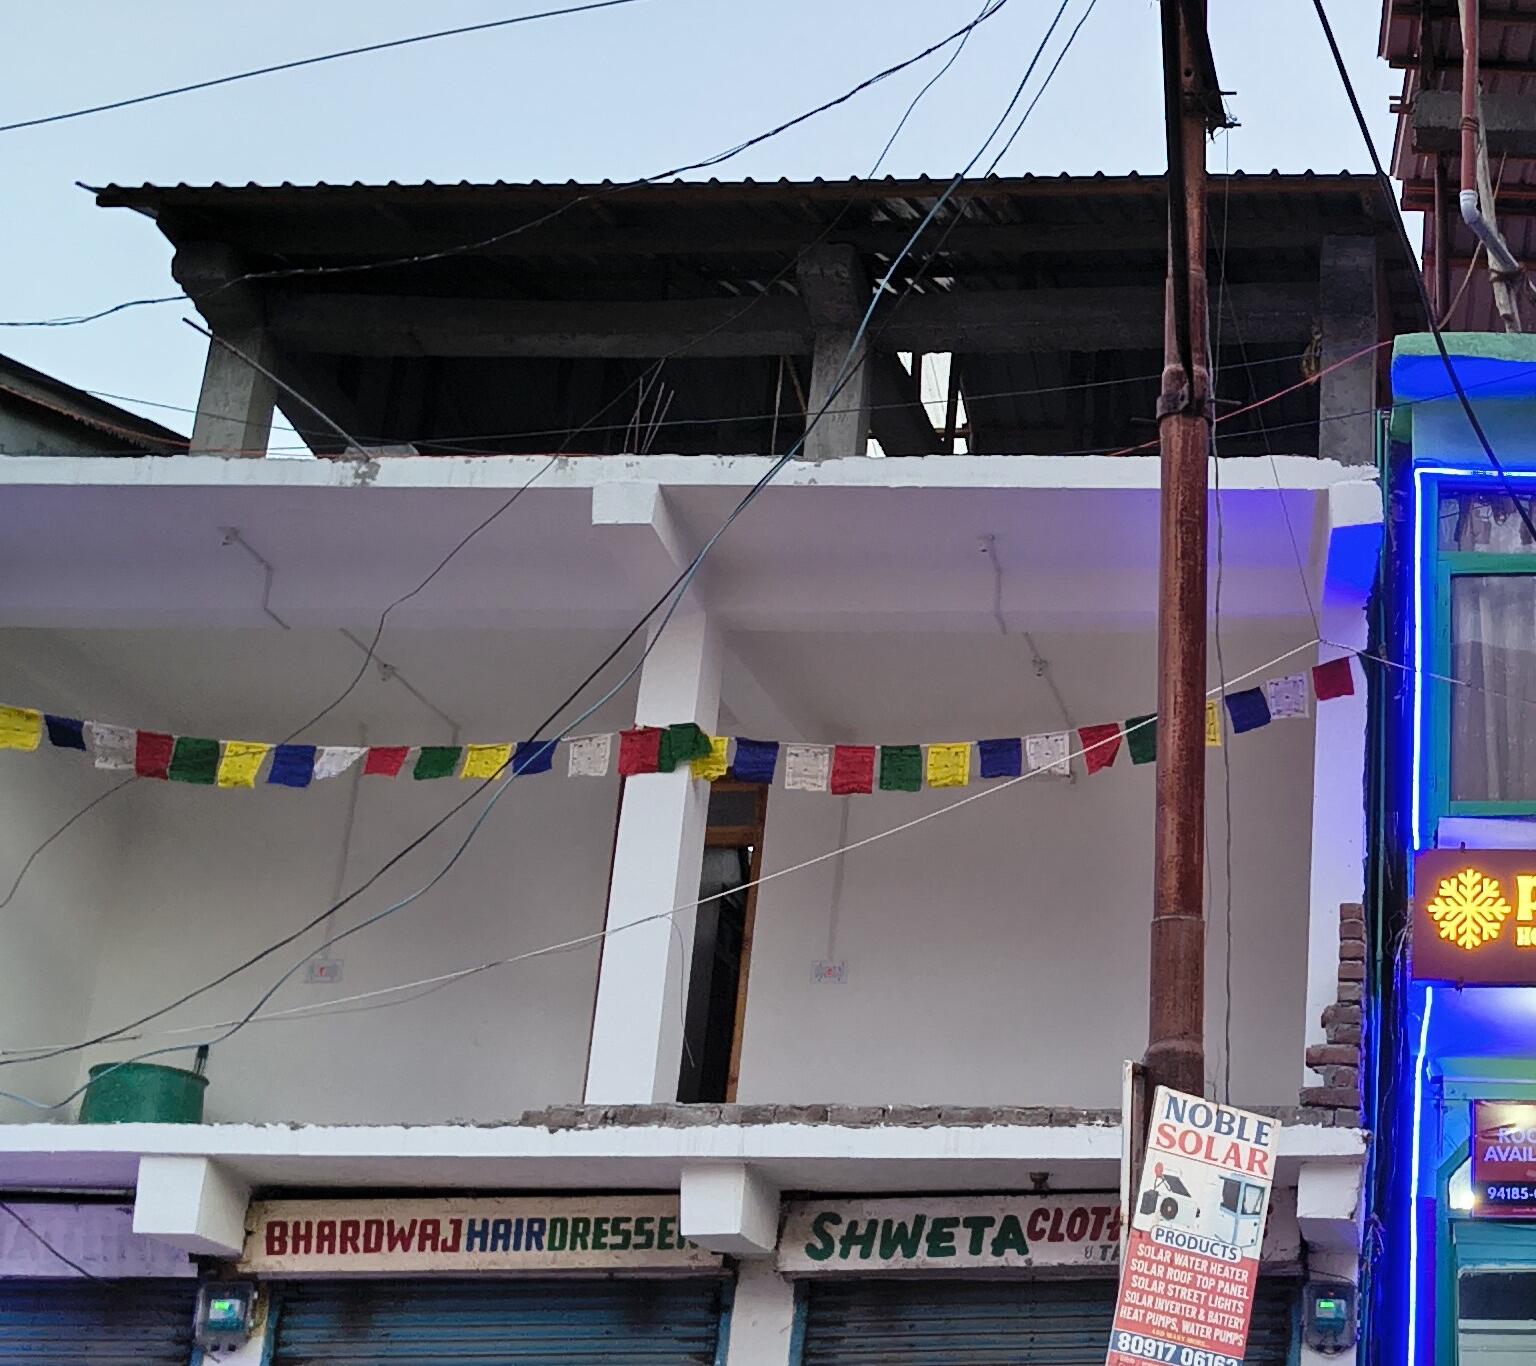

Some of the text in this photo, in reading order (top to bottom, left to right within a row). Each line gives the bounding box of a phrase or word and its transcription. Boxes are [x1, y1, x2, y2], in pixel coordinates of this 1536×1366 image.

[1164, 1096, 1275, 1147] NOBLE
[1155, 1122, 1270, 1176] SOLAR
[265, 1218, 463, 1256] BHARDWAJ
[805, 1210, 1030, 1262] SHWETA
[1155, 1227, 1238, 1261] PRODUCTS
[1130, 1259, 1249, 1300] SOLAR ROOF TOP PANEL
[1137, 1244, 1249, 1283] SOLAR WATER HEATER
[1124, 1290, 1245, 1331] SOLAR INVERTER & BATTERY
[1131, 1275, 1245, 1314] SOLAR STREET LIGHTS
[1119, 1305, 1244, 1347] HEAT PUMPS, WATER PUMPS
[1117, 1332, 1177, 1362] 80917
